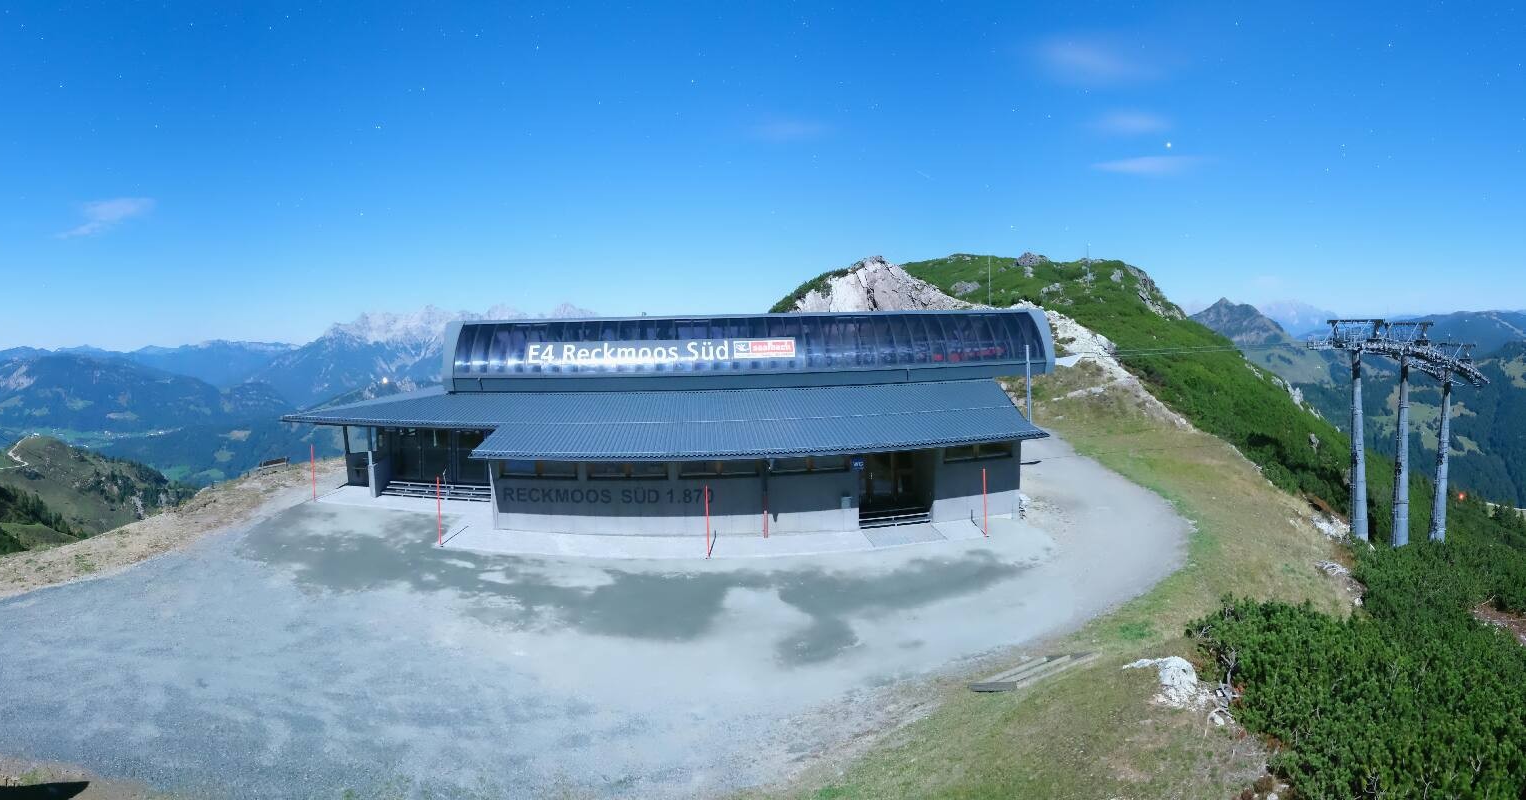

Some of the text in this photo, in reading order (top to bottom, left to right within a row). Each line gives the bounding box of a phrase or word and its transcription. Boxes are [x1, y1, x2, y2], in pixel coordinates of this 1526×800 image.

[527, 340, 730, 365] E4 Reckmoos Süd
[502, 487, 612, 504] RECKMOOS
[621, 486, 660, 504] SÜD
